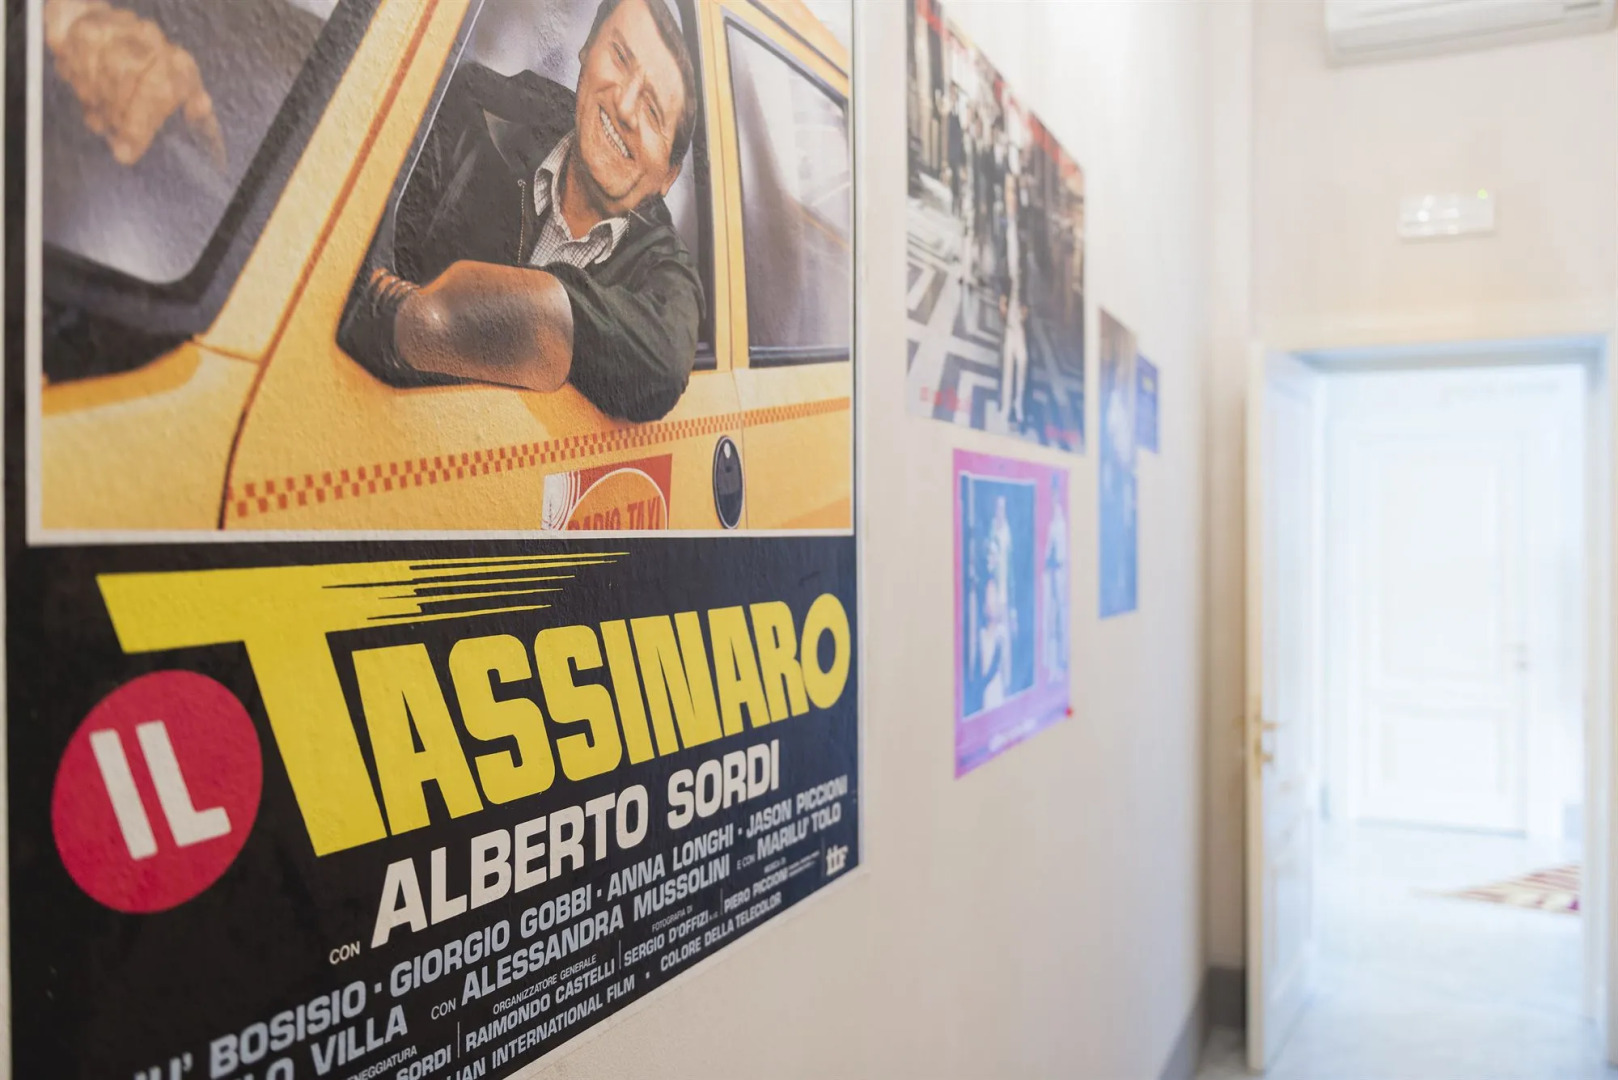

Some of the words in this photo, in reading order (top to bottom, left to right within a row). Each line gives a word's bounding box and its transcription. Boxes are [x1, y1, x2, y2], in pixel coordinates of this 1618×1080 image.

[96, 552, 850, 857] TASSINARO
[90, 720, 231, 861] IL
[811, 801, 842, 833] TOLO
[329, 941, 360, 965] CON
[371, 784, 648, 949] ALBERTO
[667, 740, 779, 830] SORDI
[210, 980, 366, 1079] BOSISIO
[390, 919, 510, 998] GIORGIO
[520, 884, 592, 939] GOBBI
[607, 856, 666, 900] ANNA
[672, 822, 734, 871] LONGHI
[746, 798, 792, 838] JASON
[796, 774, 848, 815] PICCIONI
[431, 997, 456, 1020] CON
[461, 904, 624, 1006] ALESSANDRA
[633, 853, 731, 922] MUSSOLINI
[624, 933, 665, 967] SERGIO
[668, 909, 709, 943] D'OFFIZI
[652, 908, 686, 933] FOTOGRAFIA
[686, 904, 694, 915] DI
[724, 887, 751, 914] PIERO
[465, 993, 551, 1053] RAIMONDO
[555, 958, 615, 1004] CASTELLI
[492, 993, 604, 1070] INTERNATIONAL
[606, 974, 635, 1004] FILM
[660, 936, 702, 972] COLORE
[704, 918, 735, 947] DELLA
[735, 891, 782, 929] TELECOLOR
[492, 973, 558, 1015] ORGANIZZATORE
[559, 954, 597, 980] GENERALE
[310, 1004, 408, 1076] VILLA
[396, 1044, 452, 1080] SORDI
